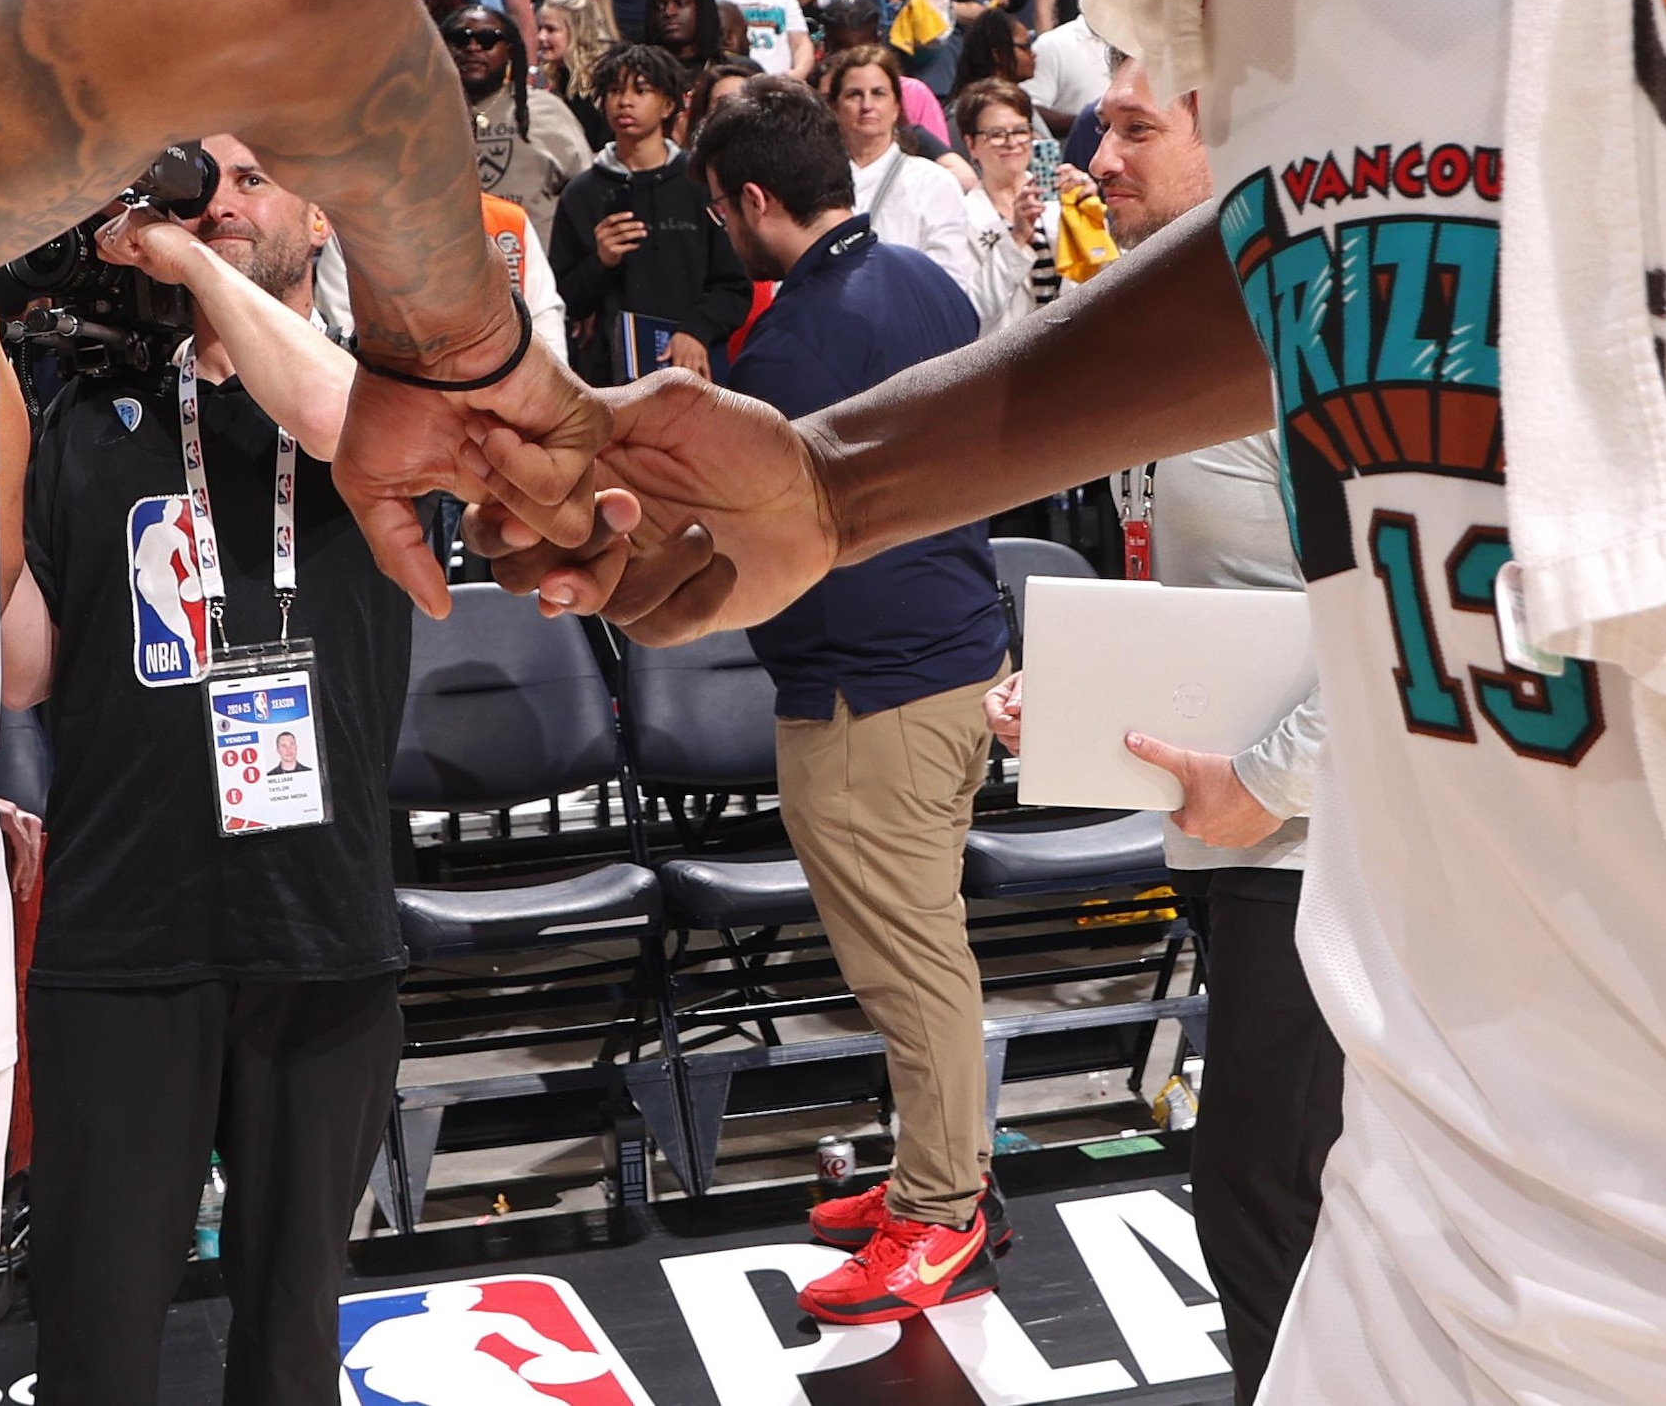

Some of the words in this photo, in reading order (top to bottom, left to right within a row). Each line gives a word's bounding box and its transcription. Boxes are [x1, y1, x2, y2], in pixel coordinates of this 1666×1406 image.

[1280, 143, 1503, 215] VANCOU
[1368, 508, 1606, 768] 13
[145, 640, 183, 675] NBA
[271, 697, 296, 710] SEASON
[224, 735, 252, 745] VENDOR
